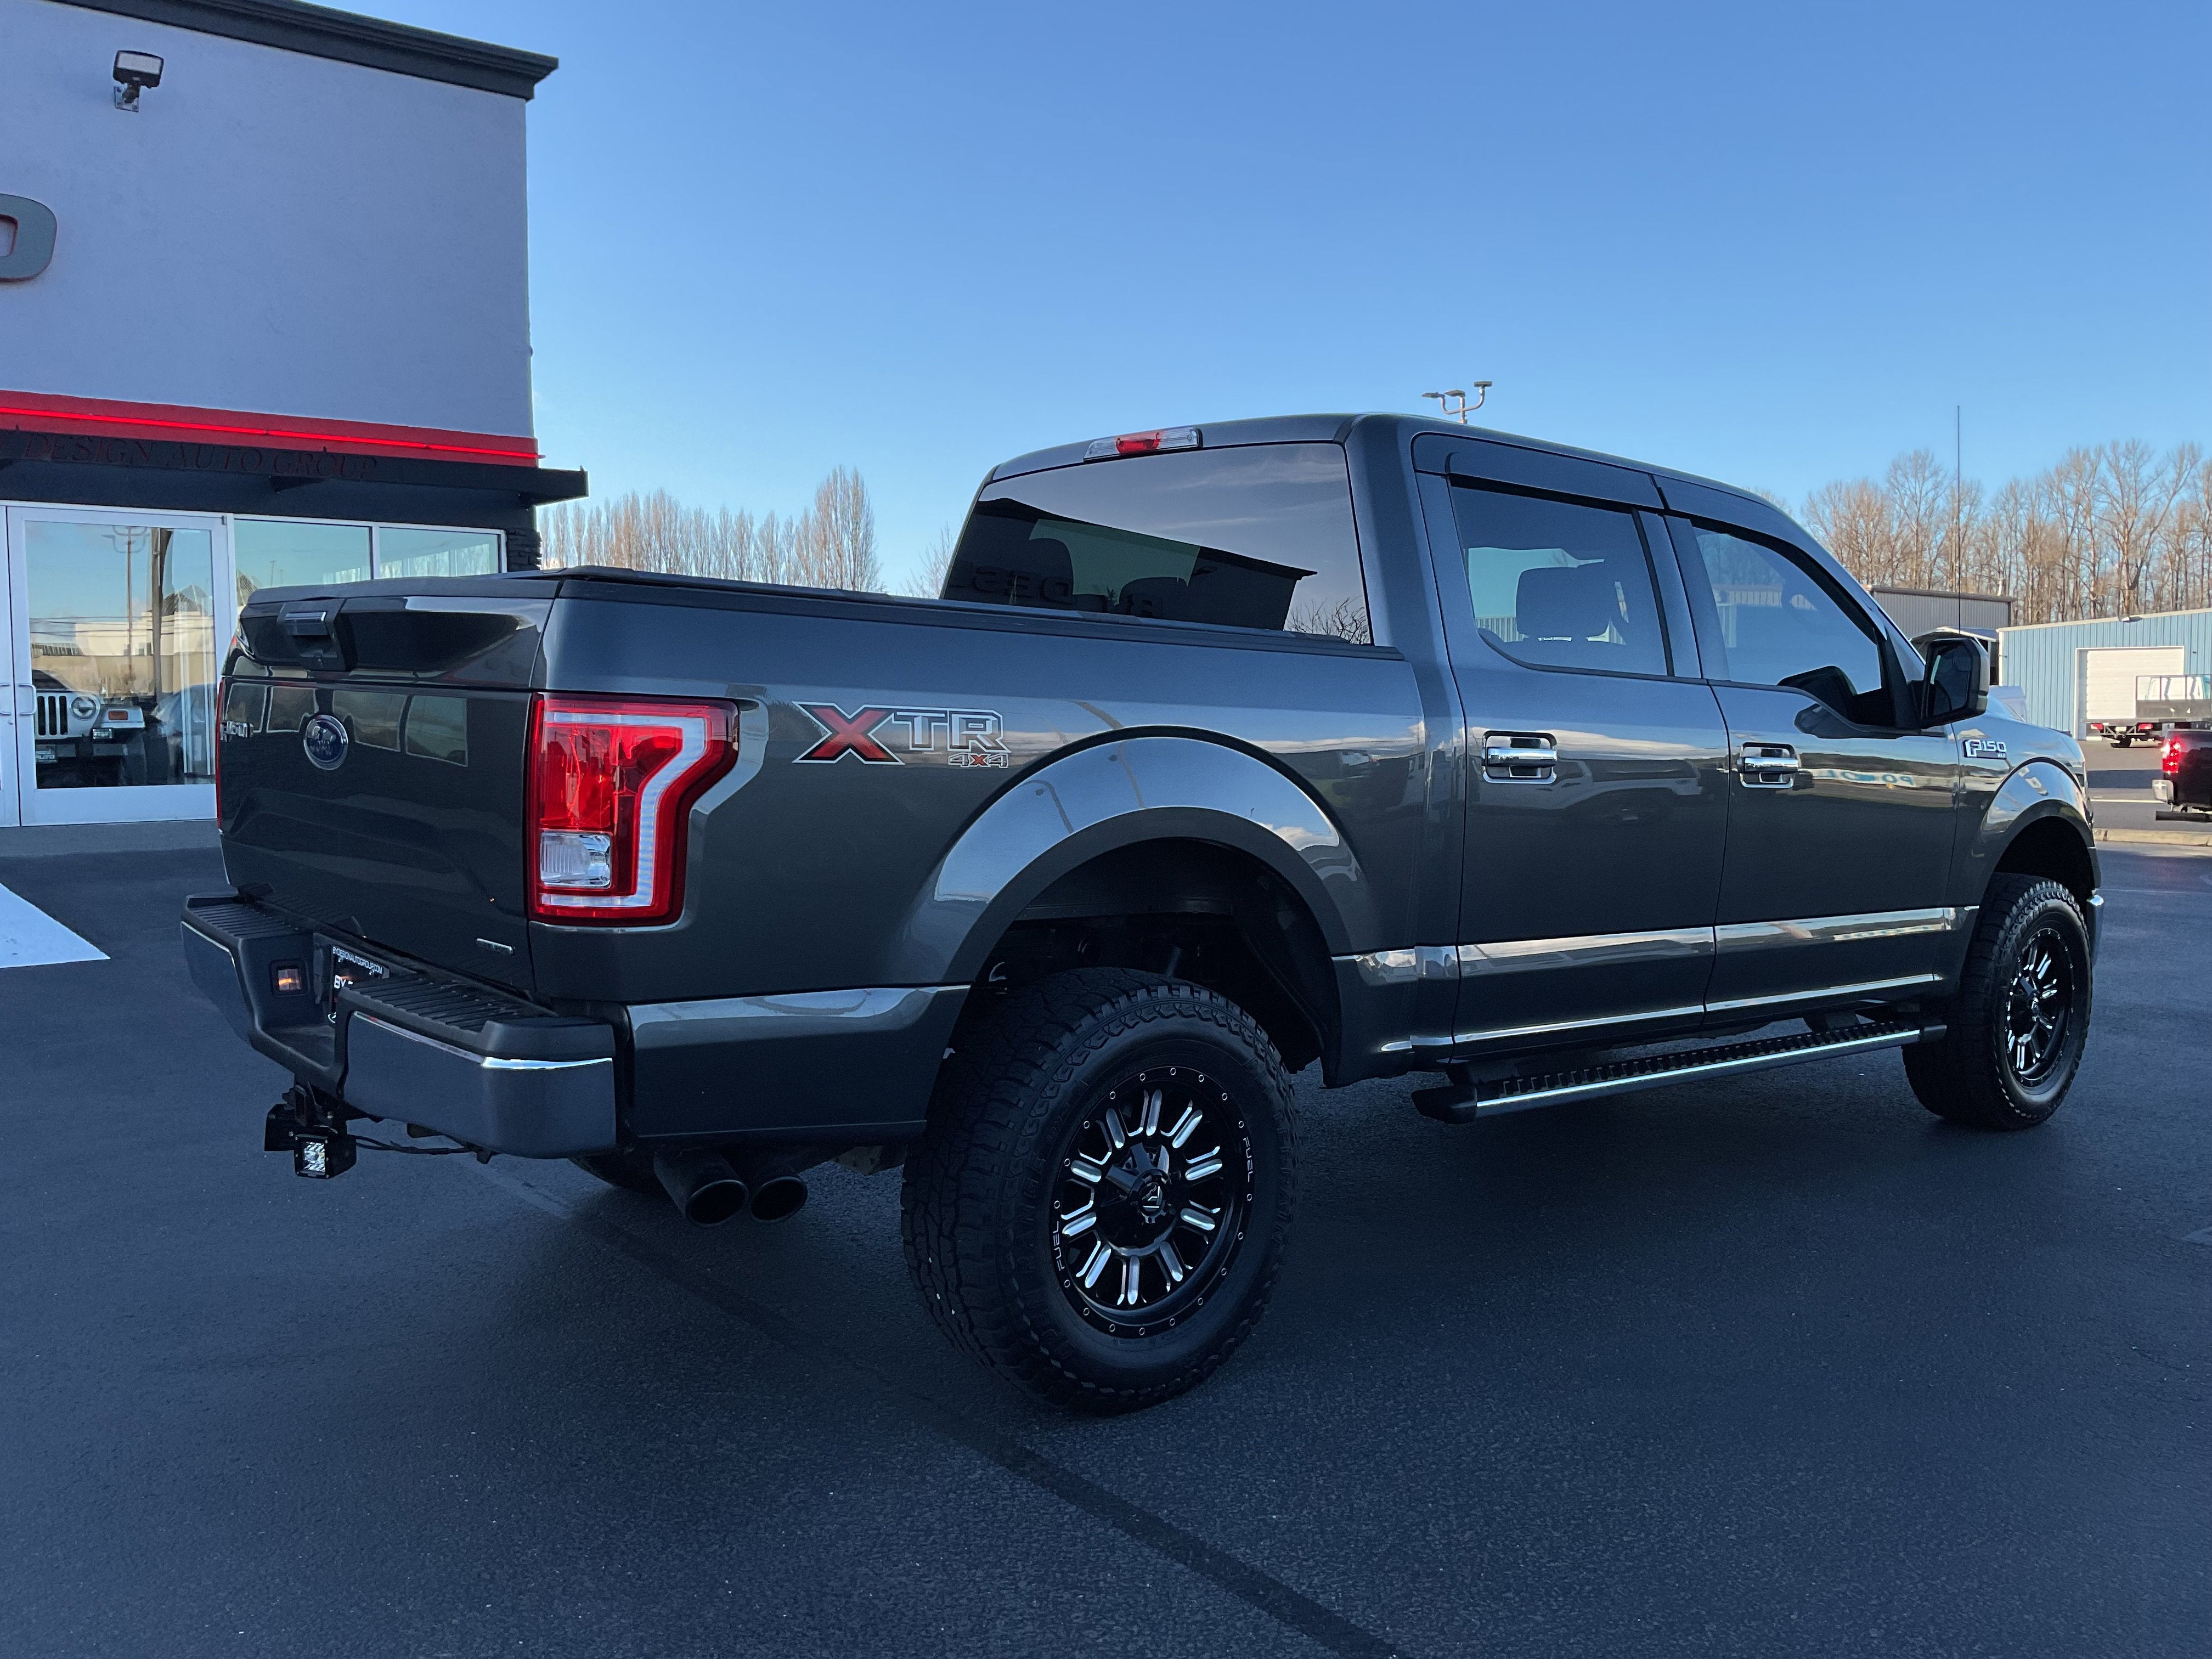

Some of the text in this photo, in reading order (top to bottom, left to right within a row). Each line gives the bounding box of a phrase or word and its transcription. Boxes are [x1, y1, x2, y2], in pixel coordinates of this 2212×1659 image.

[792, 701, 1011, 765] XTR
[1243, 1136, 1254, 1183] FUEL
[1053, 1221, 1065, 1271] FUEL
